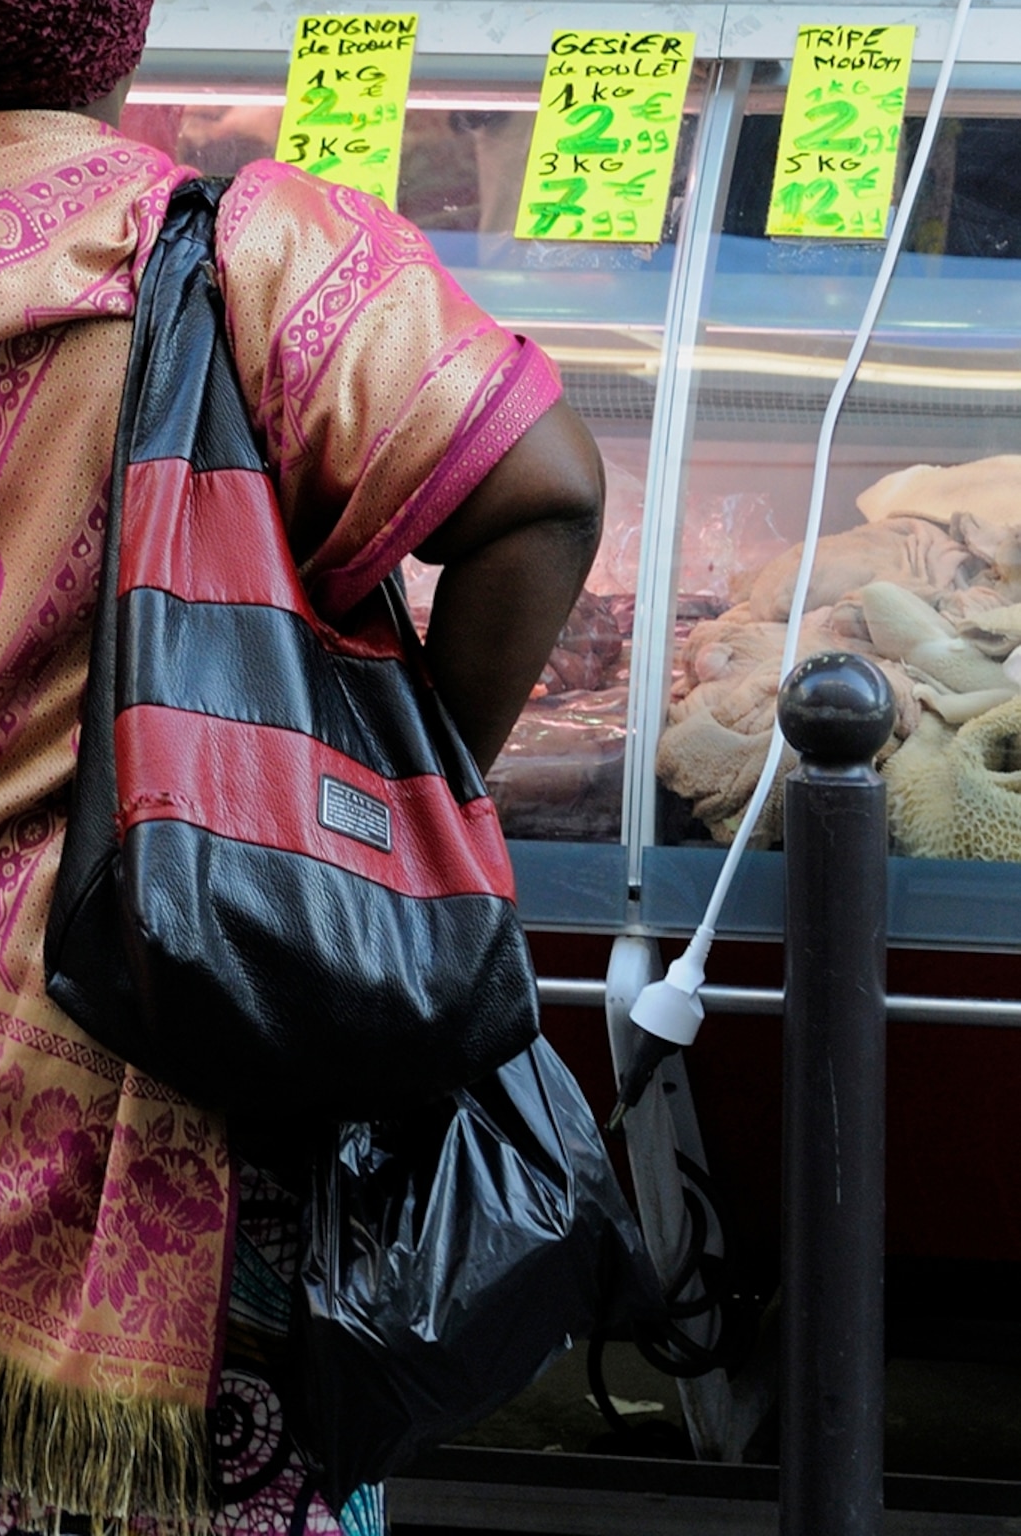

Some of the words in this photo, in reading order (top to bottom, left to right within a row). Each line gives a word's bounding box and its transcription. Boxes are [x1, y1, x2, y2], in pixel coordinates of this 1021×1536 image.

[302, 17, 415, 39] ROGNON
[298, 40, 330, 59] de
[549, 60, 577, 77] de
